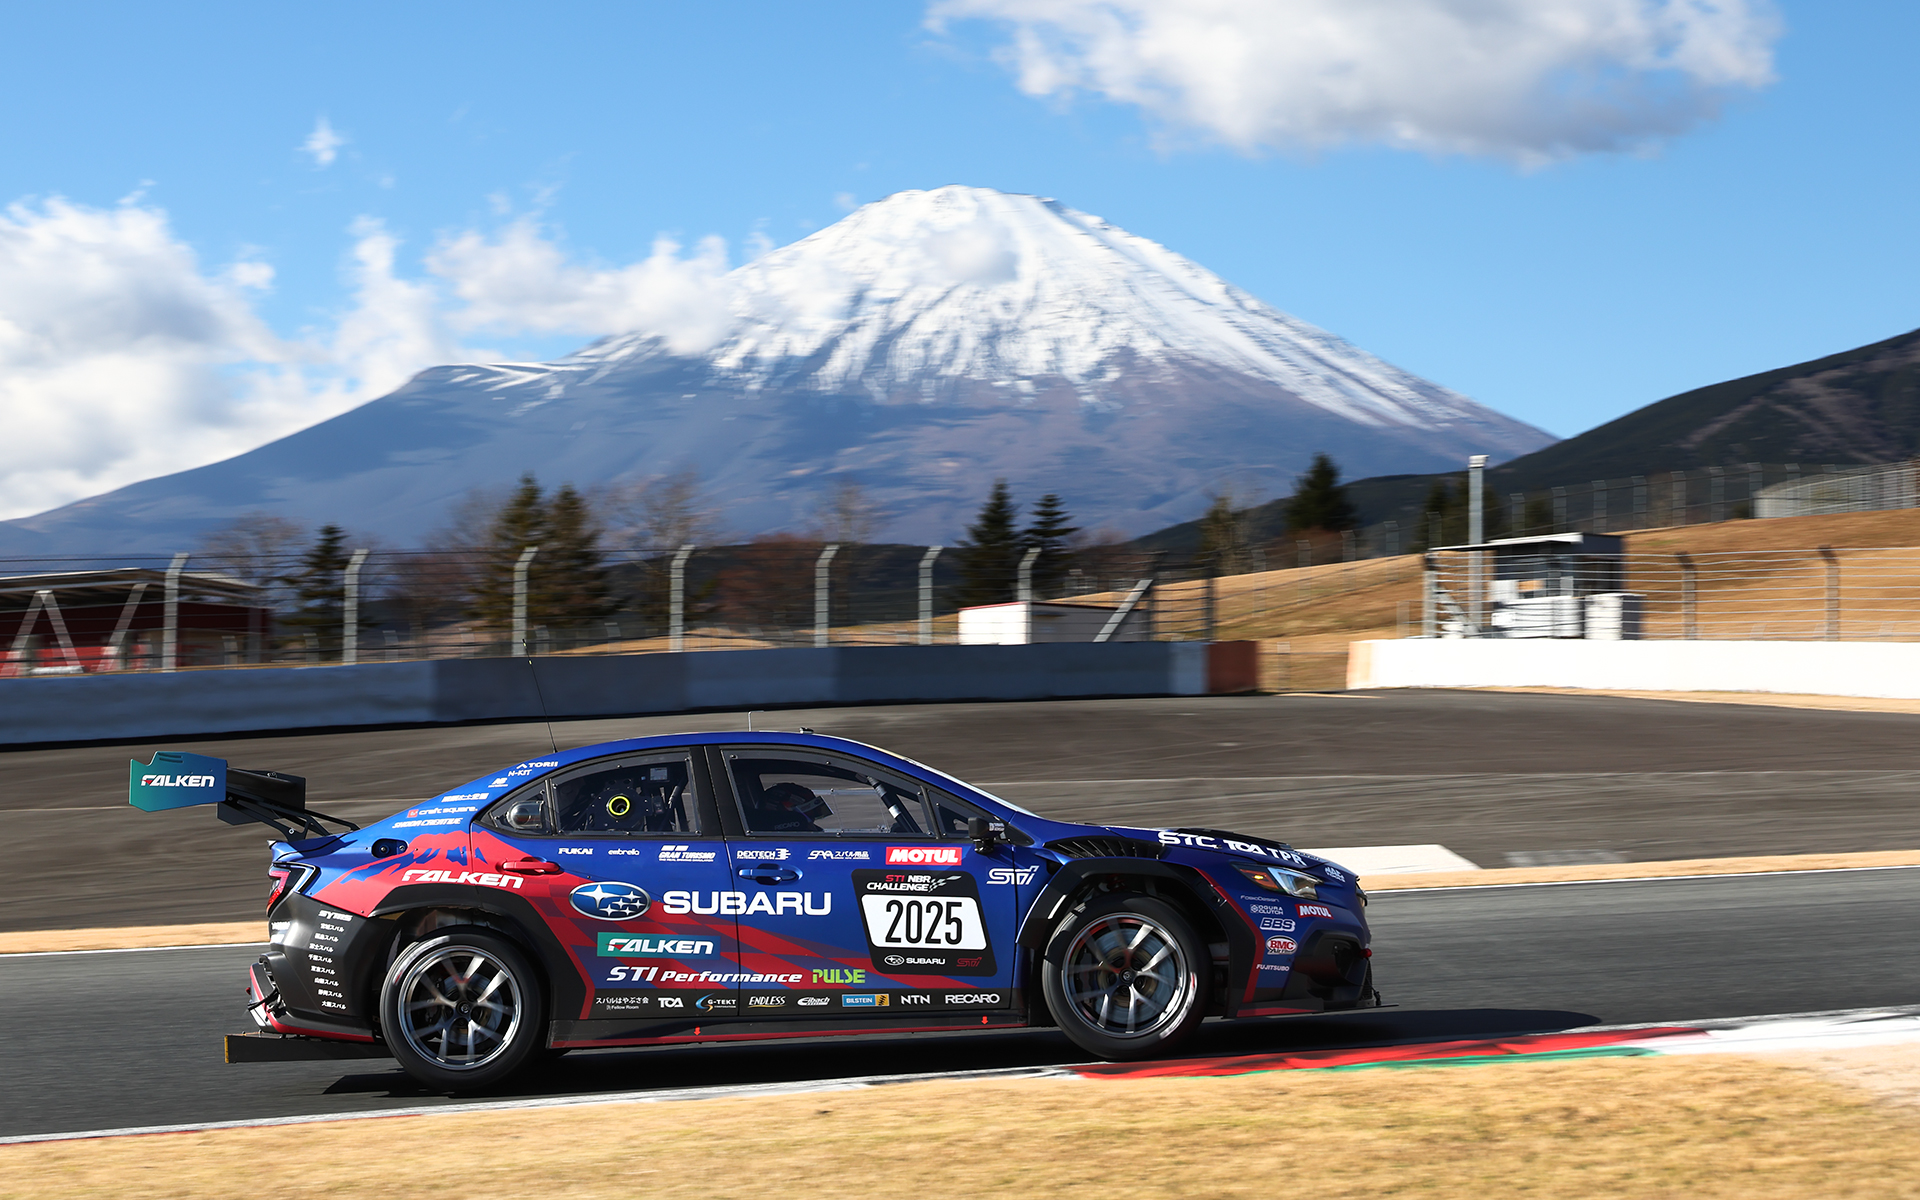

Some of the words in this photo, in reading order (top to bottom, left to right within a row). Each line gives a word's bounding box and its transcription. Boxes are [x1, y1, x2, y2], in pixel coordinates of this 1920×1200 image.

[141, 774, 215, 788] FALKEN
[558, 847, 594, 855] FUKAI
[737, 850, 776, 858] DEXTECH
[889, 848, 959, 863] MOTUL
[1223, 839, 1267, 856] TOA
[1267, 847, 1307, 867] TPR
[402, 869, 524, 889] FALKEN
[885, 874, 905, 883] STI
[907, 874, 932, 883] NBR
[866, 882, 929, 892] CHALLENGE
[663, 890, 832, 916] SUBARU
[1299, 905, 1332, 917] MOTUL
[885, 899, 963, 945] 2025
[1259, 917, 1296, 932] BBS
[606, 938, 714, 955] FALKEN
[1269, 940, 1294, 950] BMC
[906, 957, 945, 965] SUBARU
[1256, 963, 1290, 971] FUJITSUBO
[606, 966, 659, 982] STI
[660, 969, 803, 983] Performance
[812, 968, 866, 984] PULSE
[658, 997, 684, 1008] TOA
[748, 995, 786, 1006] ENDLESS
[797, 996, 830, 1006] Eibach
[901, 994, 931, 1005] NTN
[945, 993, 1000, 1004] RECARO
